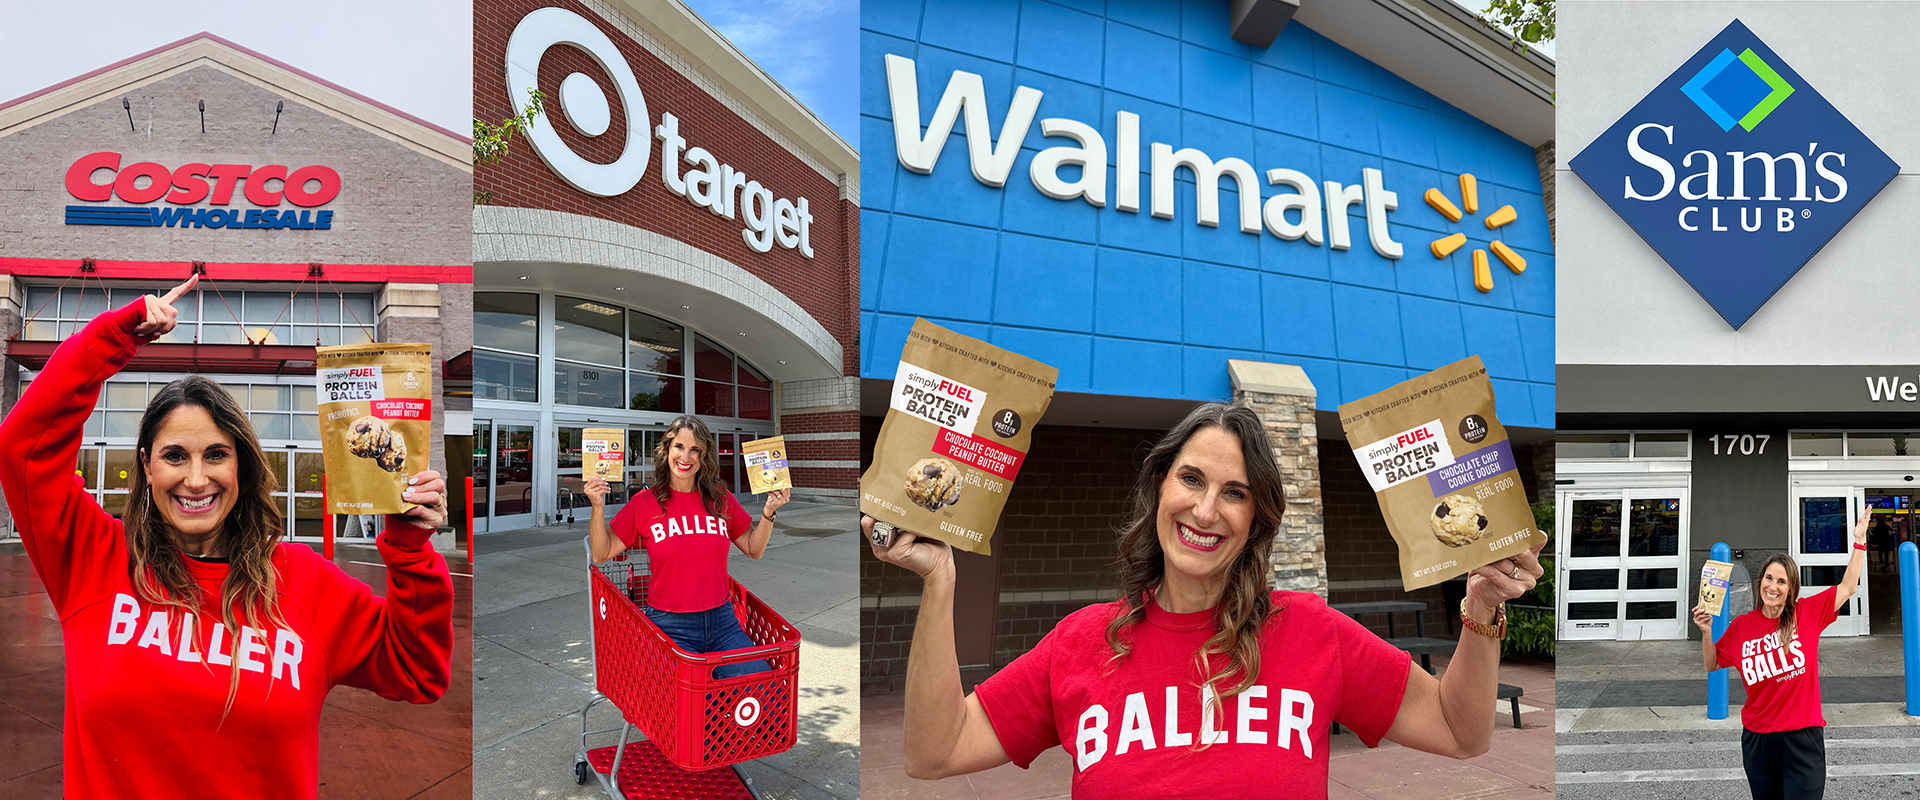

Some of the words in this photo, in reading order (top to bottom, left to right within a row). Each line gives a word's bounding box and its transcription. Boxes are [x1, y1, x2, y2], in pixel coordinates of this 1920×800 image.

[884, 53, 1403, 259] Walmart
[1623, 122, 1848, 203] Sam's
[65, 151, 341, 207] COSTCO
[655, 111, 814, 259] target
[150, 207, 334, 230] WHOLESALE
[920, 334, 931, 343] WITH
[939, 342, 958, 353] KITCHEN
[958, 349, 978, 360] CRAFTED
[978, 356, 989, 365] WITH
[997, 364, 1016, 375] KITCHEN
[1016, 371, 1036, 383] CRAFTED
[1037, 378, 1048, 387] WITH
[325, 381, 378, 392] PROTEIN
[583, 370, 599, 380] 8101
[1865, 375, 1920, 401] We
[330, 391, 372, 400] BALLS
[902, 384, 970, 418] PROTEIN
[1352, 414, 1363, 422] WITH
[1371, 404, 1390, 415] KITCHEN
[1390, 396, 1410, 408] CRAFTED
[1410, 392, 1421, 401] WITH
[1428, 383, 1448, 394] KITCHEN
[1448, 375, 1468, 387] CRAFTED
[1468, 371, 1479, 379] WITH
[327, 408, 360, 421] PROBIOTICS
[906, 399, 956, 427] BALLS
[994, 421, 1016, 434] PROTEIN
[1464, 427, 1486, 439] PROTEIN
[945, 432, 984, 454] CHOCOLATE
[984, 447, 1017, 466] COCONUT
[1373, 441, 1440, 475] PROTEIN
[1709, 434, 1771, 456] 1707
[949, 445, 977, 463] PEANUT
[977, 456, 1005, 474] BUTTER
[1385, 457, 1436, 484] BALLS
[1439, 457, 1481, 480] CHOCOLATE
[1481, 450, 1499, 465] CHIP
[964, 473, 981, 487] REAL
[983, 479, 1003, 493] FOOD
[1448, 471, 1475, 489] COOKIE
[1475, 462, 1501, 478] DOUGH
[1476, 486, 1495, 500] REAL
[1494, 477, 1514, 493] FOOD
[864, 493, 874, 501] NET
[650, 515, 729, 544] BALLER
[940, 521, 966, 537] GLUTEN
[966, 530, 983, 542] FREE
[1489, 535, 1514, 551] GLUTEN
[1514, 527, 1531, 541] FREE
[1413, 570, 1423, 578] NET
[108, 593, 303, 690] BALLER
[1742, 638, 1763, 658] GET
[1742, 640, 1805, 686] BALLS
[1076, 685, 1314, 772] BALLER
